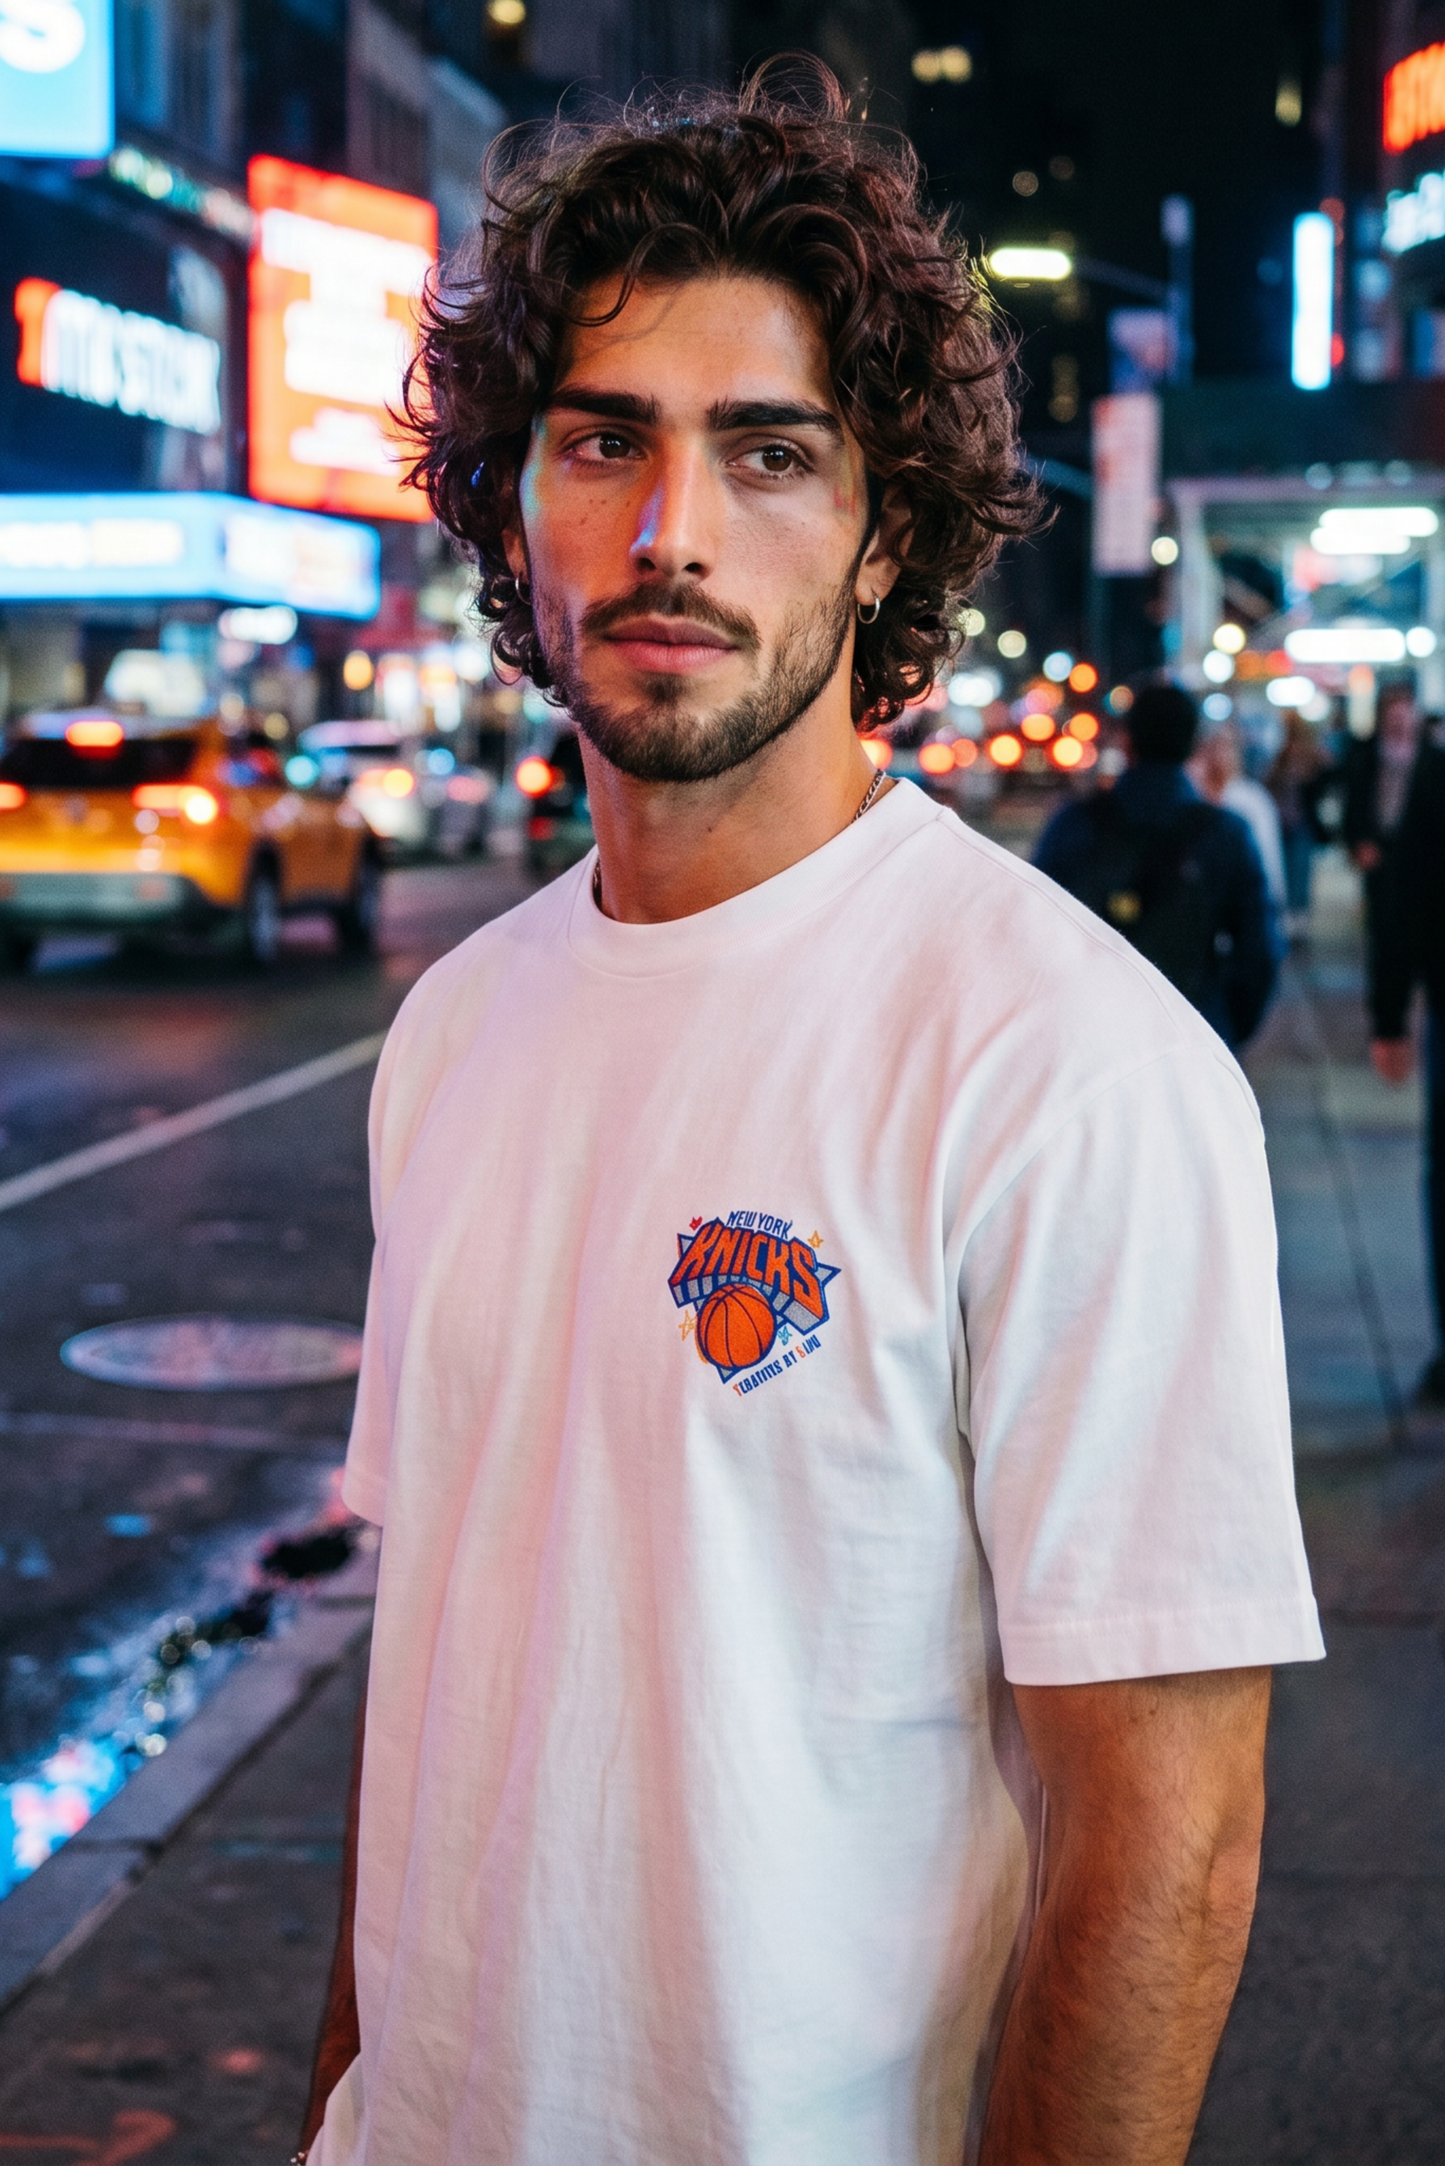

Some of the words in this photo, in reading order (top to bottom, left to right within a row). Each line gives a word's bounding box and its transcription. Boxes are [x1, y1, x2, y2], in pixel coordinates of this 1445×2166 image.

[726, 1210, 757, 1227] NEW
[758, 1212, 793, 1239] YORK
[669, 1221, 825, 1320] KNICKS
